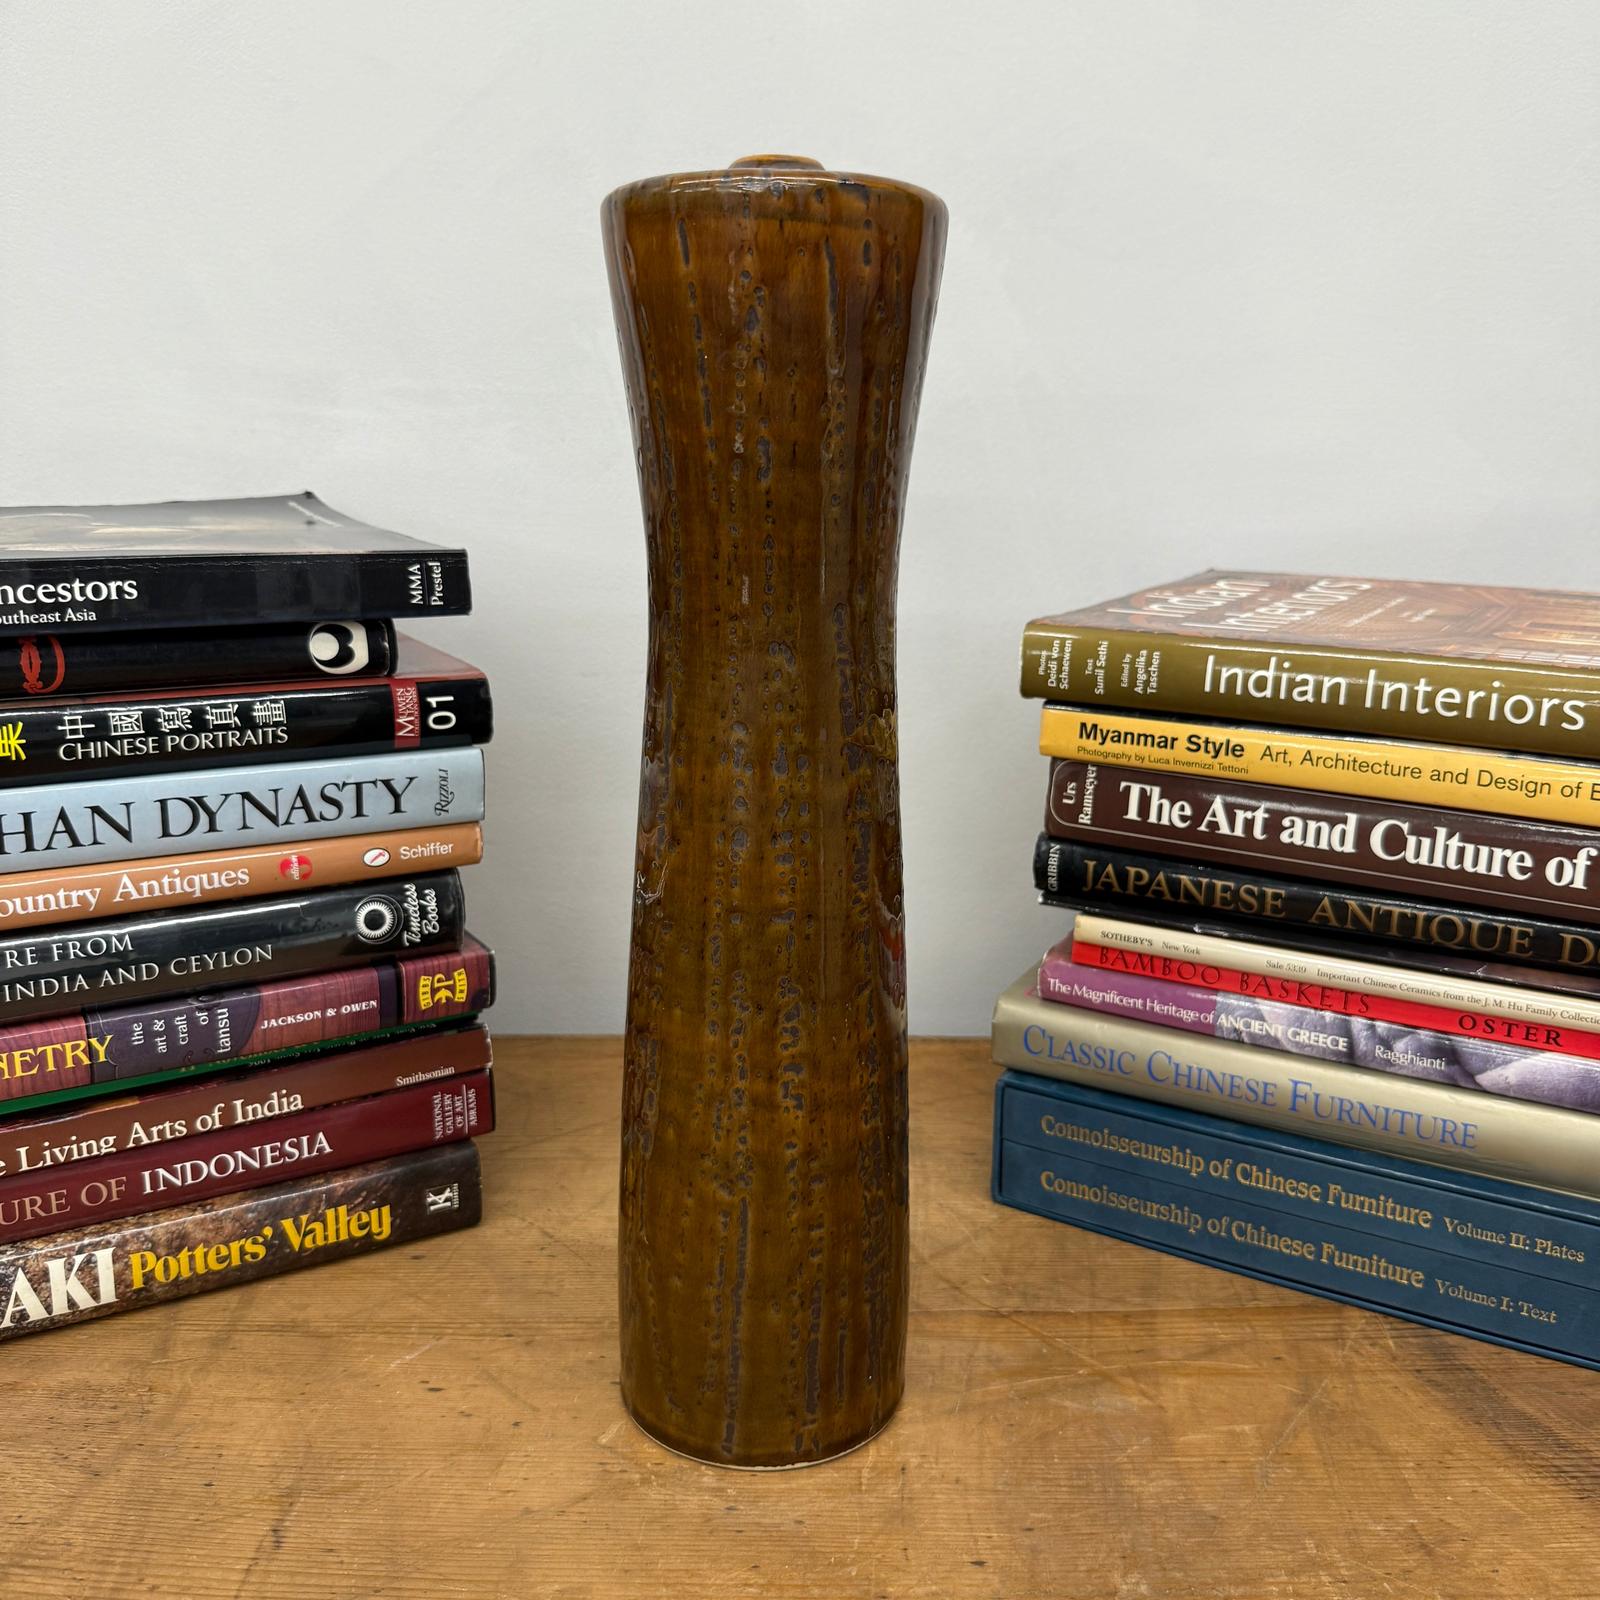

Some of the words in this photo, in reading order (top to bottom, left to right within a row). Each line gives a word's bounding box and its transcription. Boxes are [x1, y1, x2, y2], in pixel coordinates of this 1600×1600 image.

[0, 577, 138, 605] ncestors
[408, 563, 424, 605] MMA
[427, 561, 444, 606] Prestel
[65, 607, 97, 622] Asia
[1052, 640, 1060, 659] von
[1060, 640, 1072, 690] Schaewen
[1096, 641, 1109, 667] Sethi
[1123, 653, 1132, 664] by
[1048, 661, 1057, 687] Deidi
[1095, 668, 1104, 695] Sunil
[1120, 663, 1130, 687] Edited
[1134, 649, 1147, 694] Angelika
[1147, 651, 1160, 694] Taschen
[425, 695, 457, 730] 01
[1204, 655, 1348, 706] Indian
[1364, 669, 1586, 731] Interiors
[58, 736, 159, 761] CHINESE
[167, 727, 289, 752] PORTRAITS
[1077, 745, 1132, 762] Photography
[1134, 752, 1146, 764] by
[1148, 755, 1170, 766] Luca
[1172, 757, 1215, 770] Invernizzi
[1218, 762, 1249, 775] Tettoni
[1078, 722, 1178, 750] Myanmar
[1185, 734, 1245, 760] Style
[1260, 745, 1293, 767] Art,
[1301, 750, 1422, 780] Architecture
[1430, 768, 1470, 785] and
[1477, 769, 1552, 798] Design
[1560, 781, 1582, 799] of
[1062, 781, 1077, 805] Urs
[1078, 764, 1098, 825] Ramseyer
[0, 801, 135, 855] HAN
[154, 776, 418, 839] DYNASTY
[1119, 781, 1193, 828] The
[1197, 794, 1270, 840] Art
[1280, 812, 1357, 853] and
[1369, 818, 1535, 881] Culture
[1545, 847, 1599, 890] of
[400, 842, 454, 860] Schiffer
[1047, 843, 1061, 892] GRIBBIN
[0, 887, 101, 918] ountry
[113, 868, 250, 902] Antiques
[420, 887, 440, 935] Books
[1082, 859, 1287, 919] JAPANESE
[1308, 895, 1535, 957] ANTIQUE
[1558, 933, 1600, 967] D
[402, 882, 421, 947] Timeless
[5, 946, 38, 969] RE
[52, 934, 134, 962] FROM
[3, 973, 90, 1002] INDIA
[100, 962, 160, 988] AND
[170, 944, 273, 975] CEYLON
[1101, 930, 1153, 947] SOTHEBY'S
[1162, 941, 1180, 952] New
[1182, 945, 1201, 955] York
[1266, 959, 1284, 970] Sale
[1316, 968, 1360, 984] Important
[1362, 976, 1397, 990] Chinese
[1399, 982, 1441, 998] Ceramics
[1442, 990, 1464, 1002] from
[1466, 993, 1481, 1004] the
[1482, 998, 1491, 1008] J.
[1492, 999, 1505, 1009] M.
[1508, 1001, 1523, 1012] Hu
[1525, 1004, 1558, 1018] Family
[196, 1010, 209, 1025] of
[261, 1005, 322, 1030] JACKSON
[326, 1008, 337, 1017] &
[341, 1000, 378, 1014] OWEN
[1099, 946, 1222, 985] BAMBOO
[1239, 972, 1370, 1014] BASKETS
[1458, 1014, 1563, 1047] OSTER
[131, 1022, 144, 1046] the
[153, 1019, 166, 1030] &
[157, 1035, 168, 1053] art
[175, 1014, 188, 1045] craft
[217, 1007, 231, 1053] tansu
[1047, 977, 1071, 994] The
[1072, 983, 1144, 1011] Magnificent
[1146, 998, 1199, 1022] Heritage
[1200, 1011, 1216, 1025] of
[1217, 1013, 1284, 1038] ANCIENT
[1287, 1027, 1349, 1052] GREECE
[1375, 1045, 1446, 1071] Ragghianti
[396, 1065, 456, 1088] Smithsonian
[1023, 1025, 1136, 1076] CLASSIC
[1147, 1050, 1278, 1108] CHINESE
[1288, 1078, 1479, 1150] FURNITURE
[432, 1091, 444, 1141] NATIONAL
[443, 1093, 453, 1135] GALLERY
[454, 1095, 464, 1112] ART
[455, 1114, 464, 1128] OF
[467, 1088, 478, 1126] ABRAMS
[16, 1135, 116, 1173] Living
[126, 1118, 187, 1148] Arts
[196, 1103, 226, 1129] of
[233, 1088, 305, 1125] India
[0, 1188, 71, 1226] URE
[80, 1176, 128, 1206] OF
[141, 1131, 333, 1195] INDONESIA
[1040, 1114, 1204, 1176] Connoisseurship
[1208, 1158, 1233, 1179] of
[1235, 1162, 1322, 1202] Chinese
[1327, 1183, 1433, 1229] Furniture
[1443, 1216, 1506, 1245] Volume
[1509, 1232, 1531, 1250] II:
[1535, 1237, 1586, 1263] Plates
[1, 1246, 121, 1329] AKI
[280, 1204, 392, 1253] Valley
[1040, 1170, 1203, 1234] Connoisseurship
[1207, 1216, 1229, 1237] of
[1231, 1220, 1316, 1261] Chinese
[1321, 1242, 1425, 1289] Furniture
[1435, 1278, 1497, 1308] Volume
[1500, 1297, 1514, 1313] I:
[1518, 1301, 1558, 1324] Text
